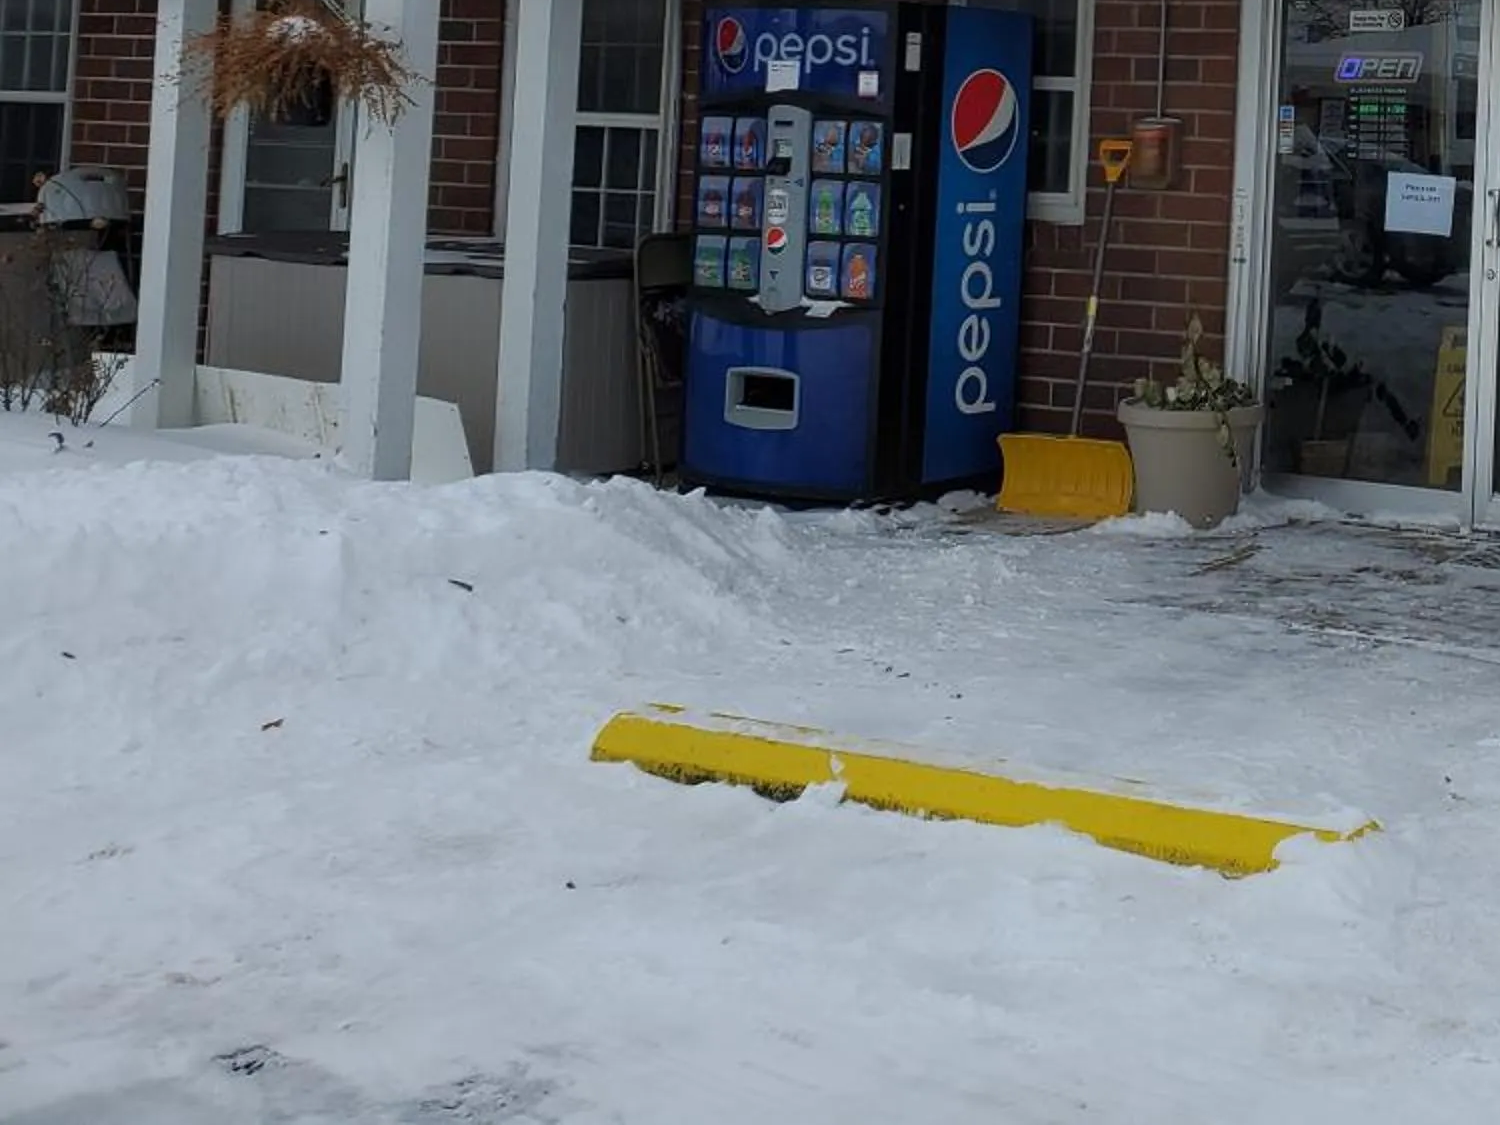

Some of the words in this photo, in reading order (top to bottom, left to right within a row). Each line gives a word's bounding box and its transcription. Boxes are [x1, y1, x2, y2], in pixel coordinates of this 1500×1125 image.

[754, 26, 870, 74] pepsi
[1340, 58, 1417, 77] OPEN
[956, 202, 1001, 414] pepsi
